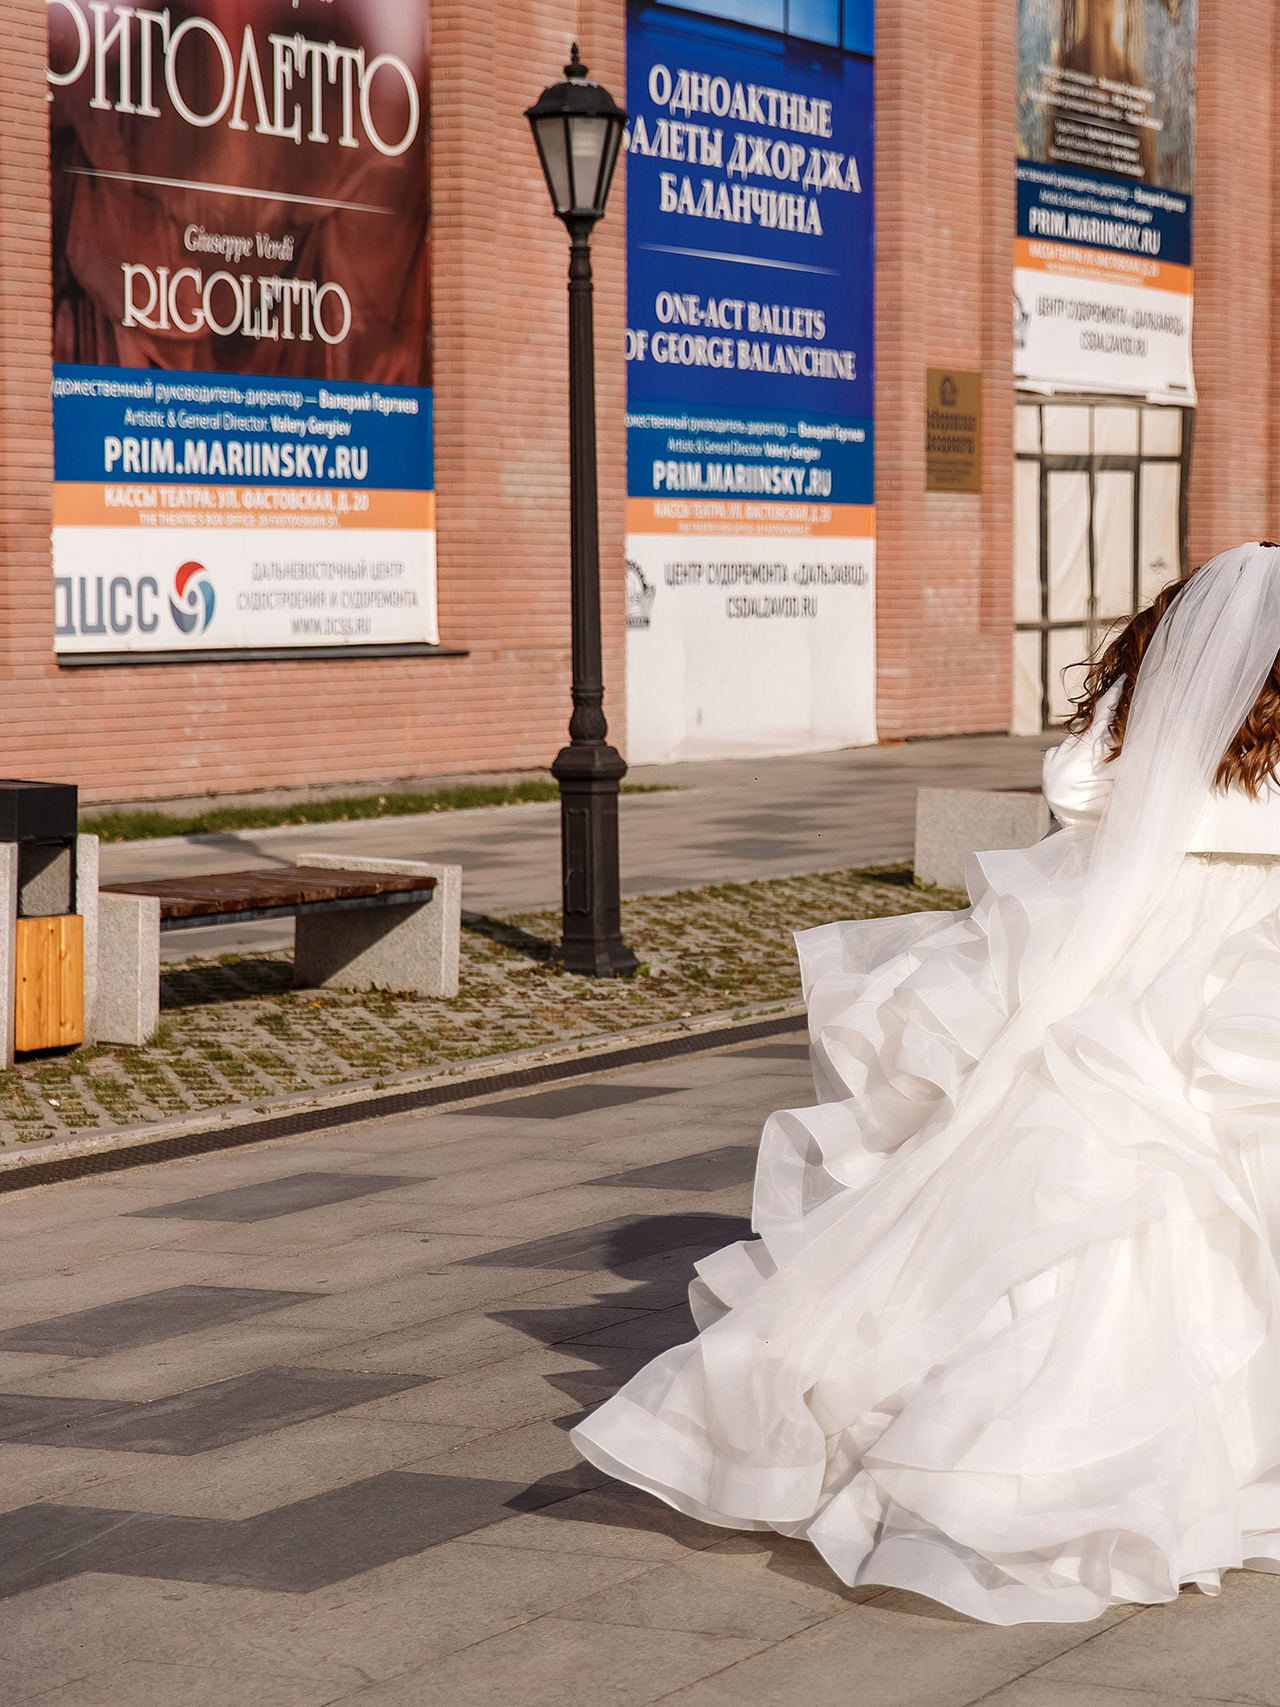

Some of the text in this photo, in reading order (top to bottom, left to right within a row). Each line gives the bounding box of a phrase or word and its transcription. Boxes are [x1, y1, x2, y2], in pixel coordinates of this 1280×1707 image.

[648, 63, 833, 139] ОДНОАКТНЫЕ
[726, 132, 862, 195] ДЖОРДЖА
[659, 171, 823, 236] БАЛАНЧИНА
[184, 224, 295, 263] Giuseppe Verdi
[121, 262, 352, 345] RIGOLETTO
[656, 290, 826, 341] ONE-ACT BALLETS
[624, 328, 857, 381] OF GEORGE BALANCHINE
[124, 406, 165, 428] Artistic
[166, 408, 177, 428] &
[177, 409, 221, 431] General
[270, 412, 307, 438] Valery
[307, 415, 352, 440] Gergiev
[104, 436, 368, 480] PRIM.MARIINSKY.RU
[652, 460, 832, 497] PRIM.MARIINSKY.RU
[104, 486, 156, 508] КАССЫ
[352, 492, 370, 512] 20
[664, 561, 703, 589] ЦЕНТР
[328, 592, 339, 610] И
